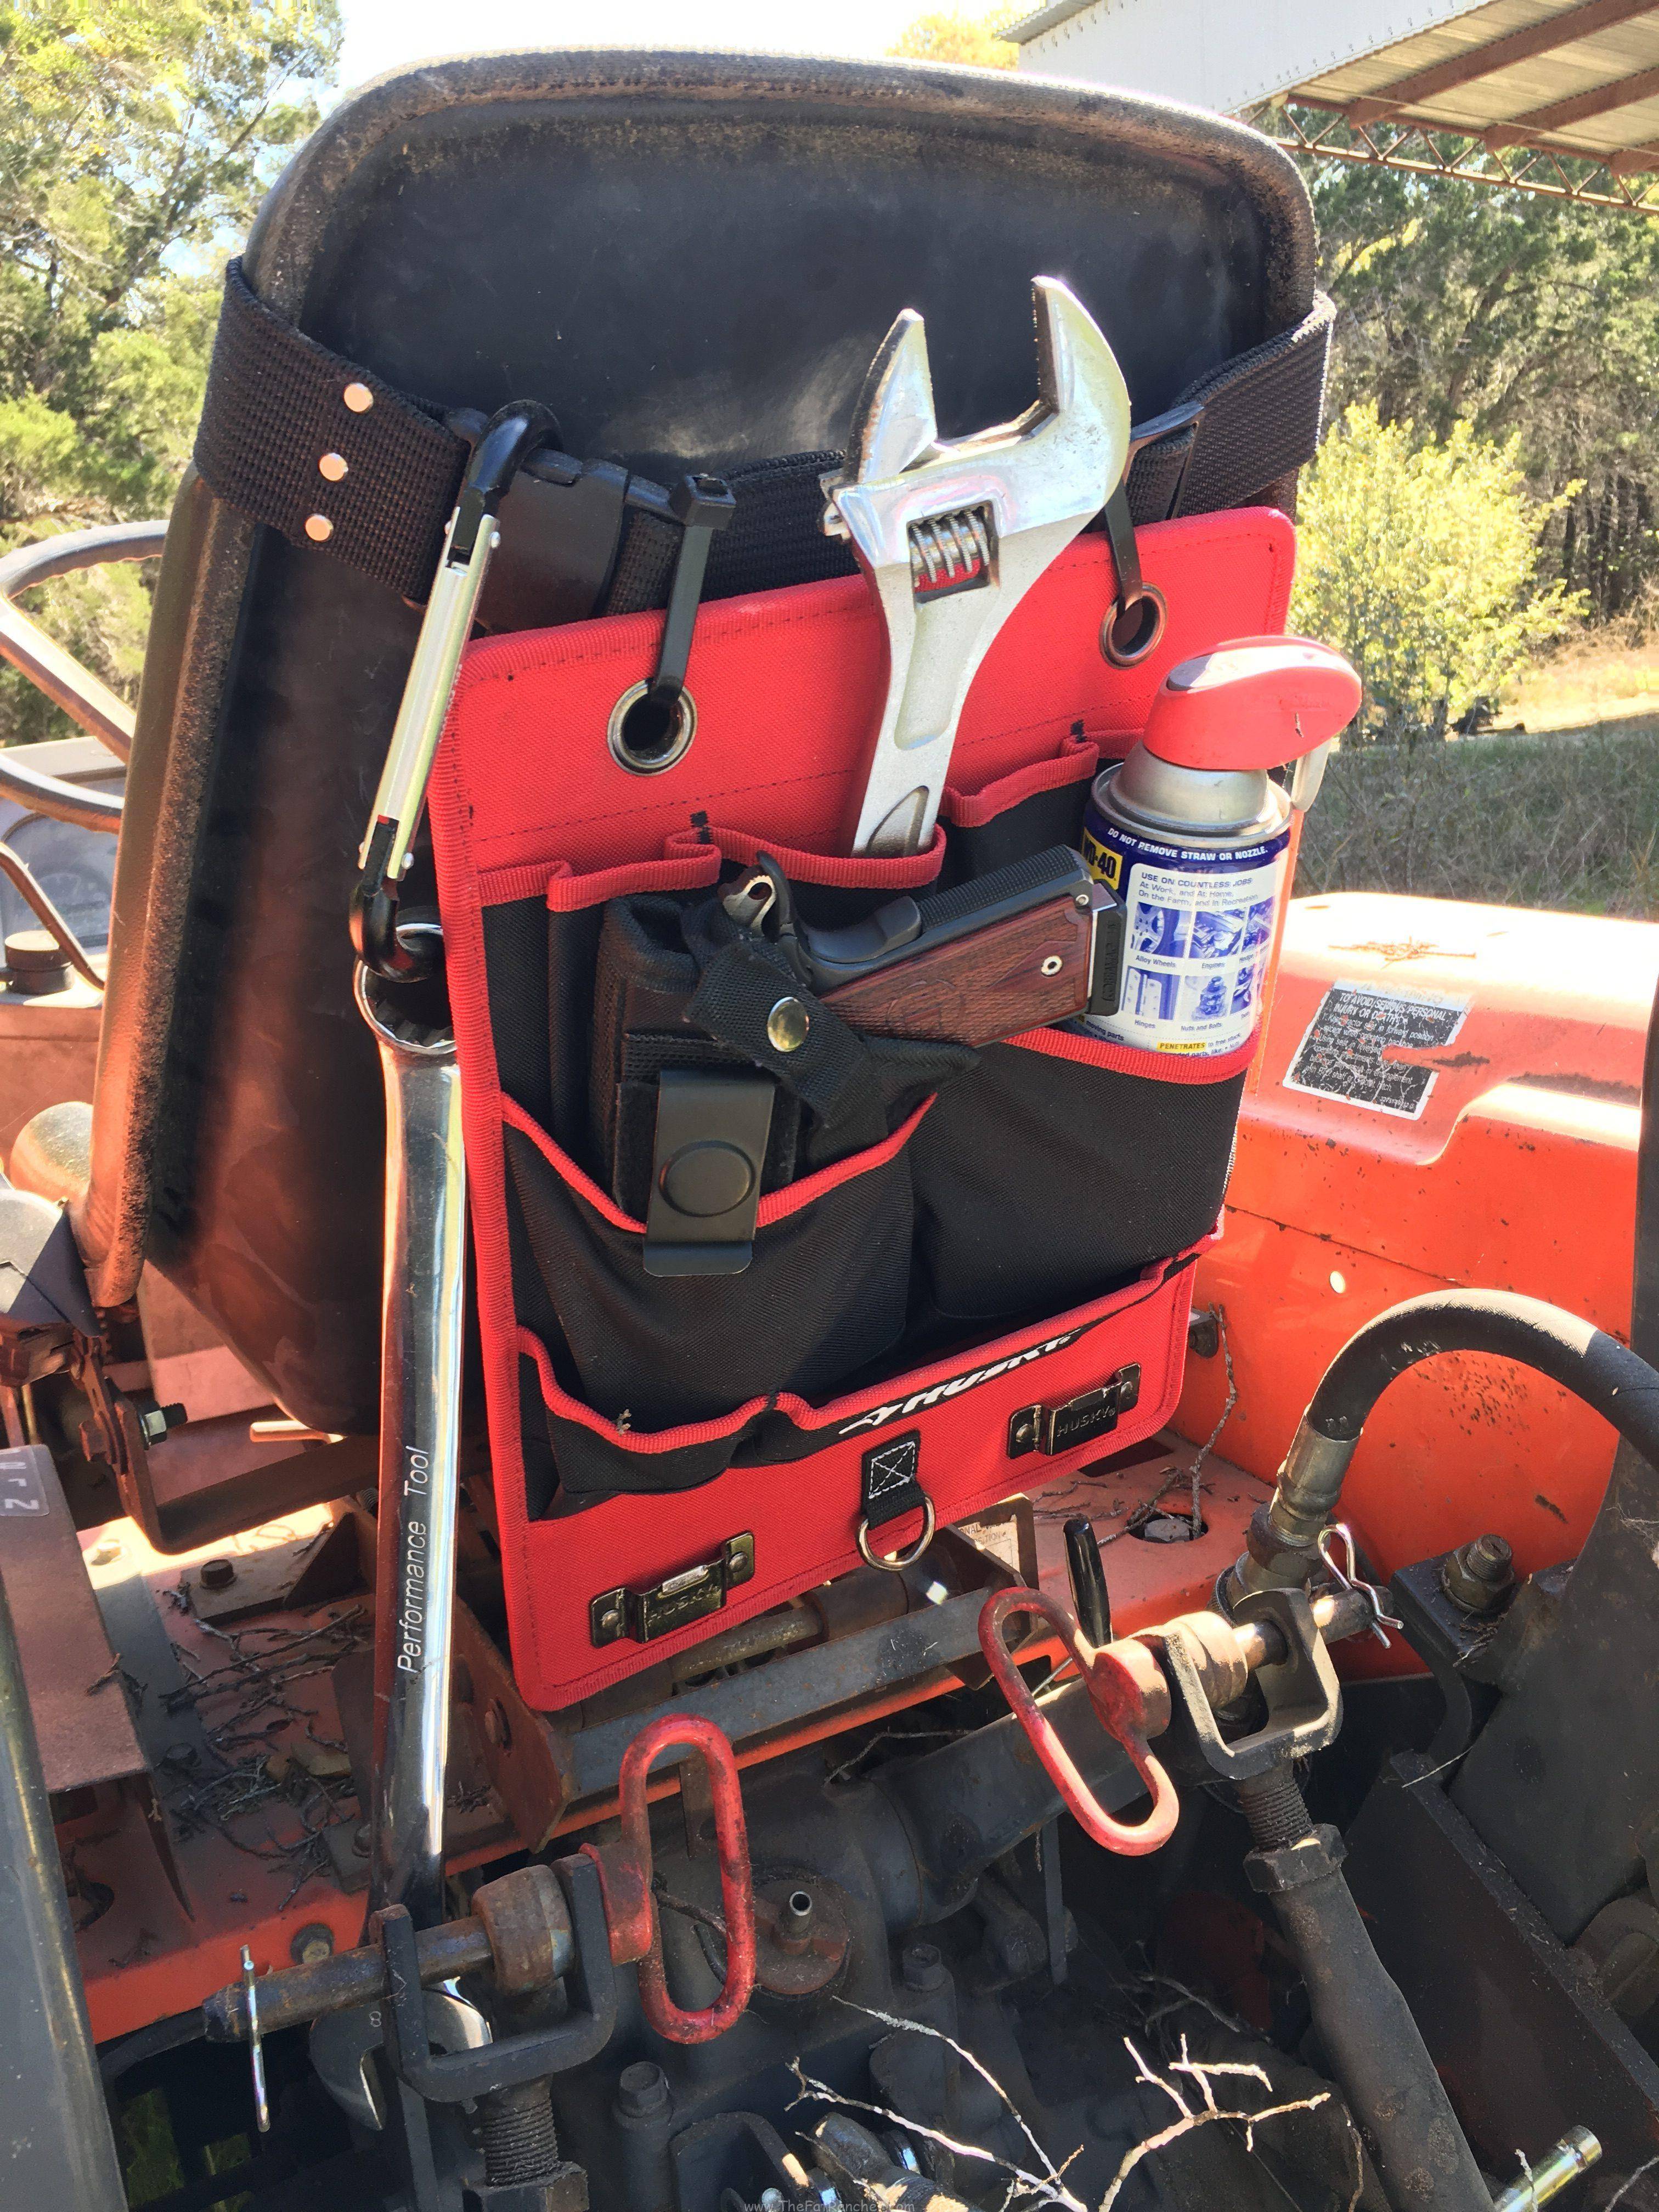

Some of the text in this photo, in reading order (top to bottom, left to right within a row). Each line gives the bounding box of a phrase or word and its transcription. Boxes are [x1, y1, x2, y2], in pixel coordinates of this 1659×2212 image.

[1107, 827, 1268, 861] DO NOT REMOVE STRAW OR NOZZLE.
[1141, 871, 1254, 889] USE ON COUNTLESS JOBS
[1138, 889, 1149, 898] On
[1151, 893, 1164, 901] the
[1167, 896, 1192, 906] Farm,
[1152, 883, 1176, 896] Work,
[1179, 889, 1195, 898] and
[1197, 890, 1208, 898] At
[1135, 955, 1177, 968] Alloy Wheels
[1333, 1003, 1359, 1015] INJURY
[1358, 1007, 1372, 1019] OR
[1339, 992, 1352, 1003] TO
[1351, 994, 1374, 1007] AVOID
[1407, 1005, 1447, 1022] PERSONAL
[1134, 1019, 1156, 1029] Hinges
[1208, 1022, 1223, 1030] Bolts
[1107, 1031, 1124, 1041] parts
[1385, 1025, 1409, 1038] forward
[1409, 1030, 1435, 1042] position
[1159, 1042, 1205, 1050] PENETRATES
[1215, 1038, 1227, 1047] free
[1056, 1405, 1109, 1438] HUSKY
[397, 1445, 430, 1674] Performance Tool
